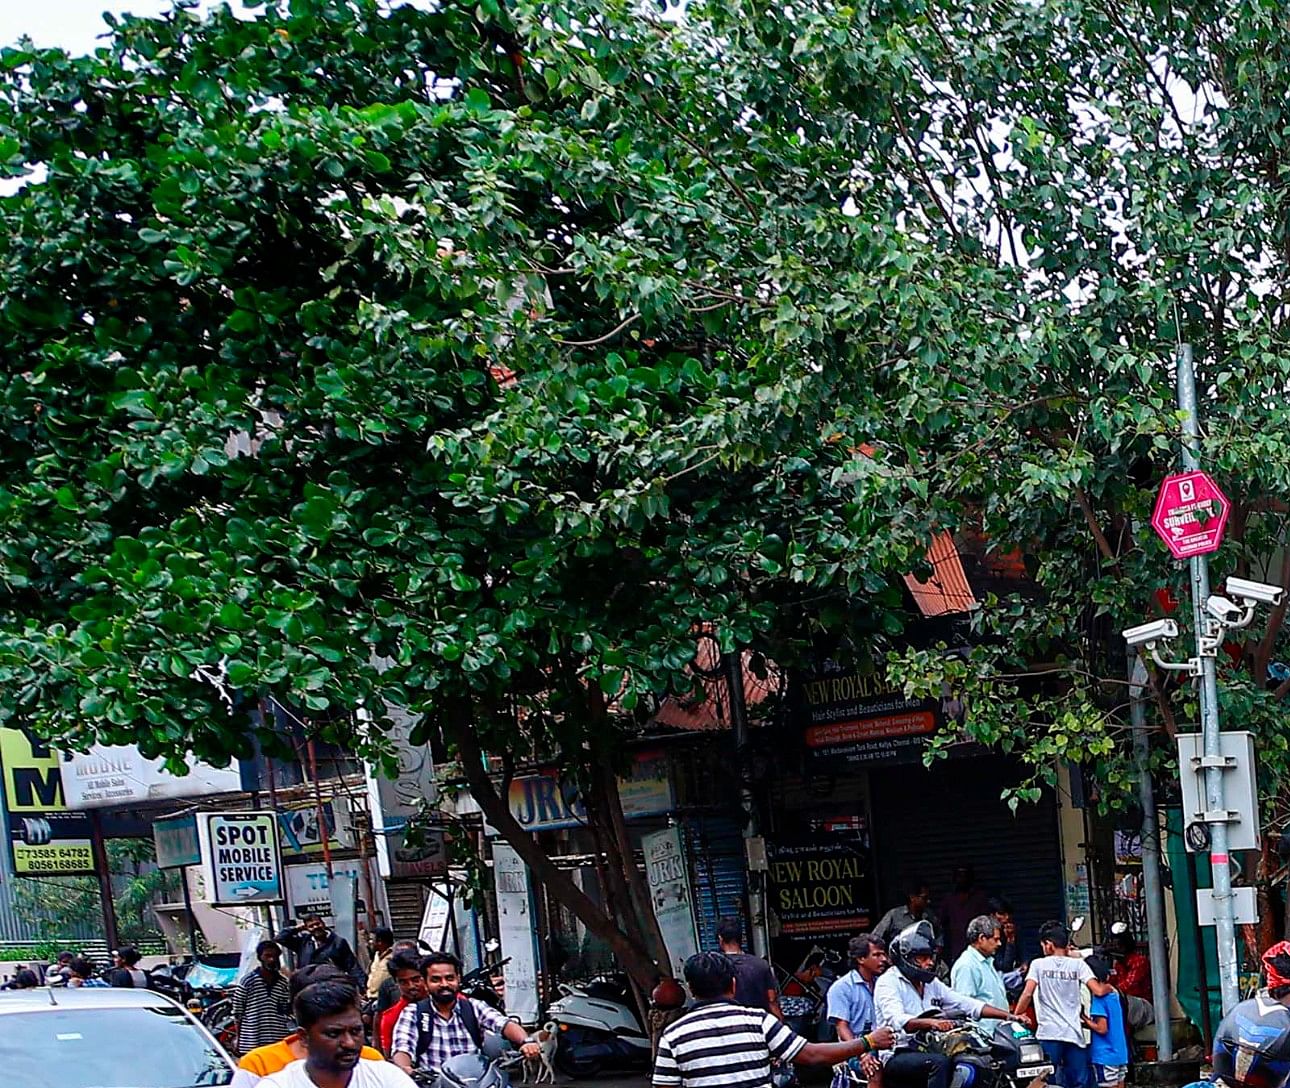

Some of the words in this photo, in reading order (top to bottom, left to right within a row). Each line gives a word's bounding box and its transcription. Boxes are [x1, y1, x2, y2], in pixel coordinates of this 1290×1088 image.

[831, 674, 872, 702] ROYAL
[216, 825, 268, 846] SPOT
[27, 849, 56, 859] 73585
[59, 848, 89, 858] 64782
[218, 847, 271, 864] MOBILE
[28, 859, 89, 870] 8056168685
[220, 865, 273, 882] SERVICE
[650, 857, 683, 887] JRK
[767, 860, 802, 883] NEW
[807, 857, 865, 881] ROYAL
[779, 884, 853, 909] SALOON
